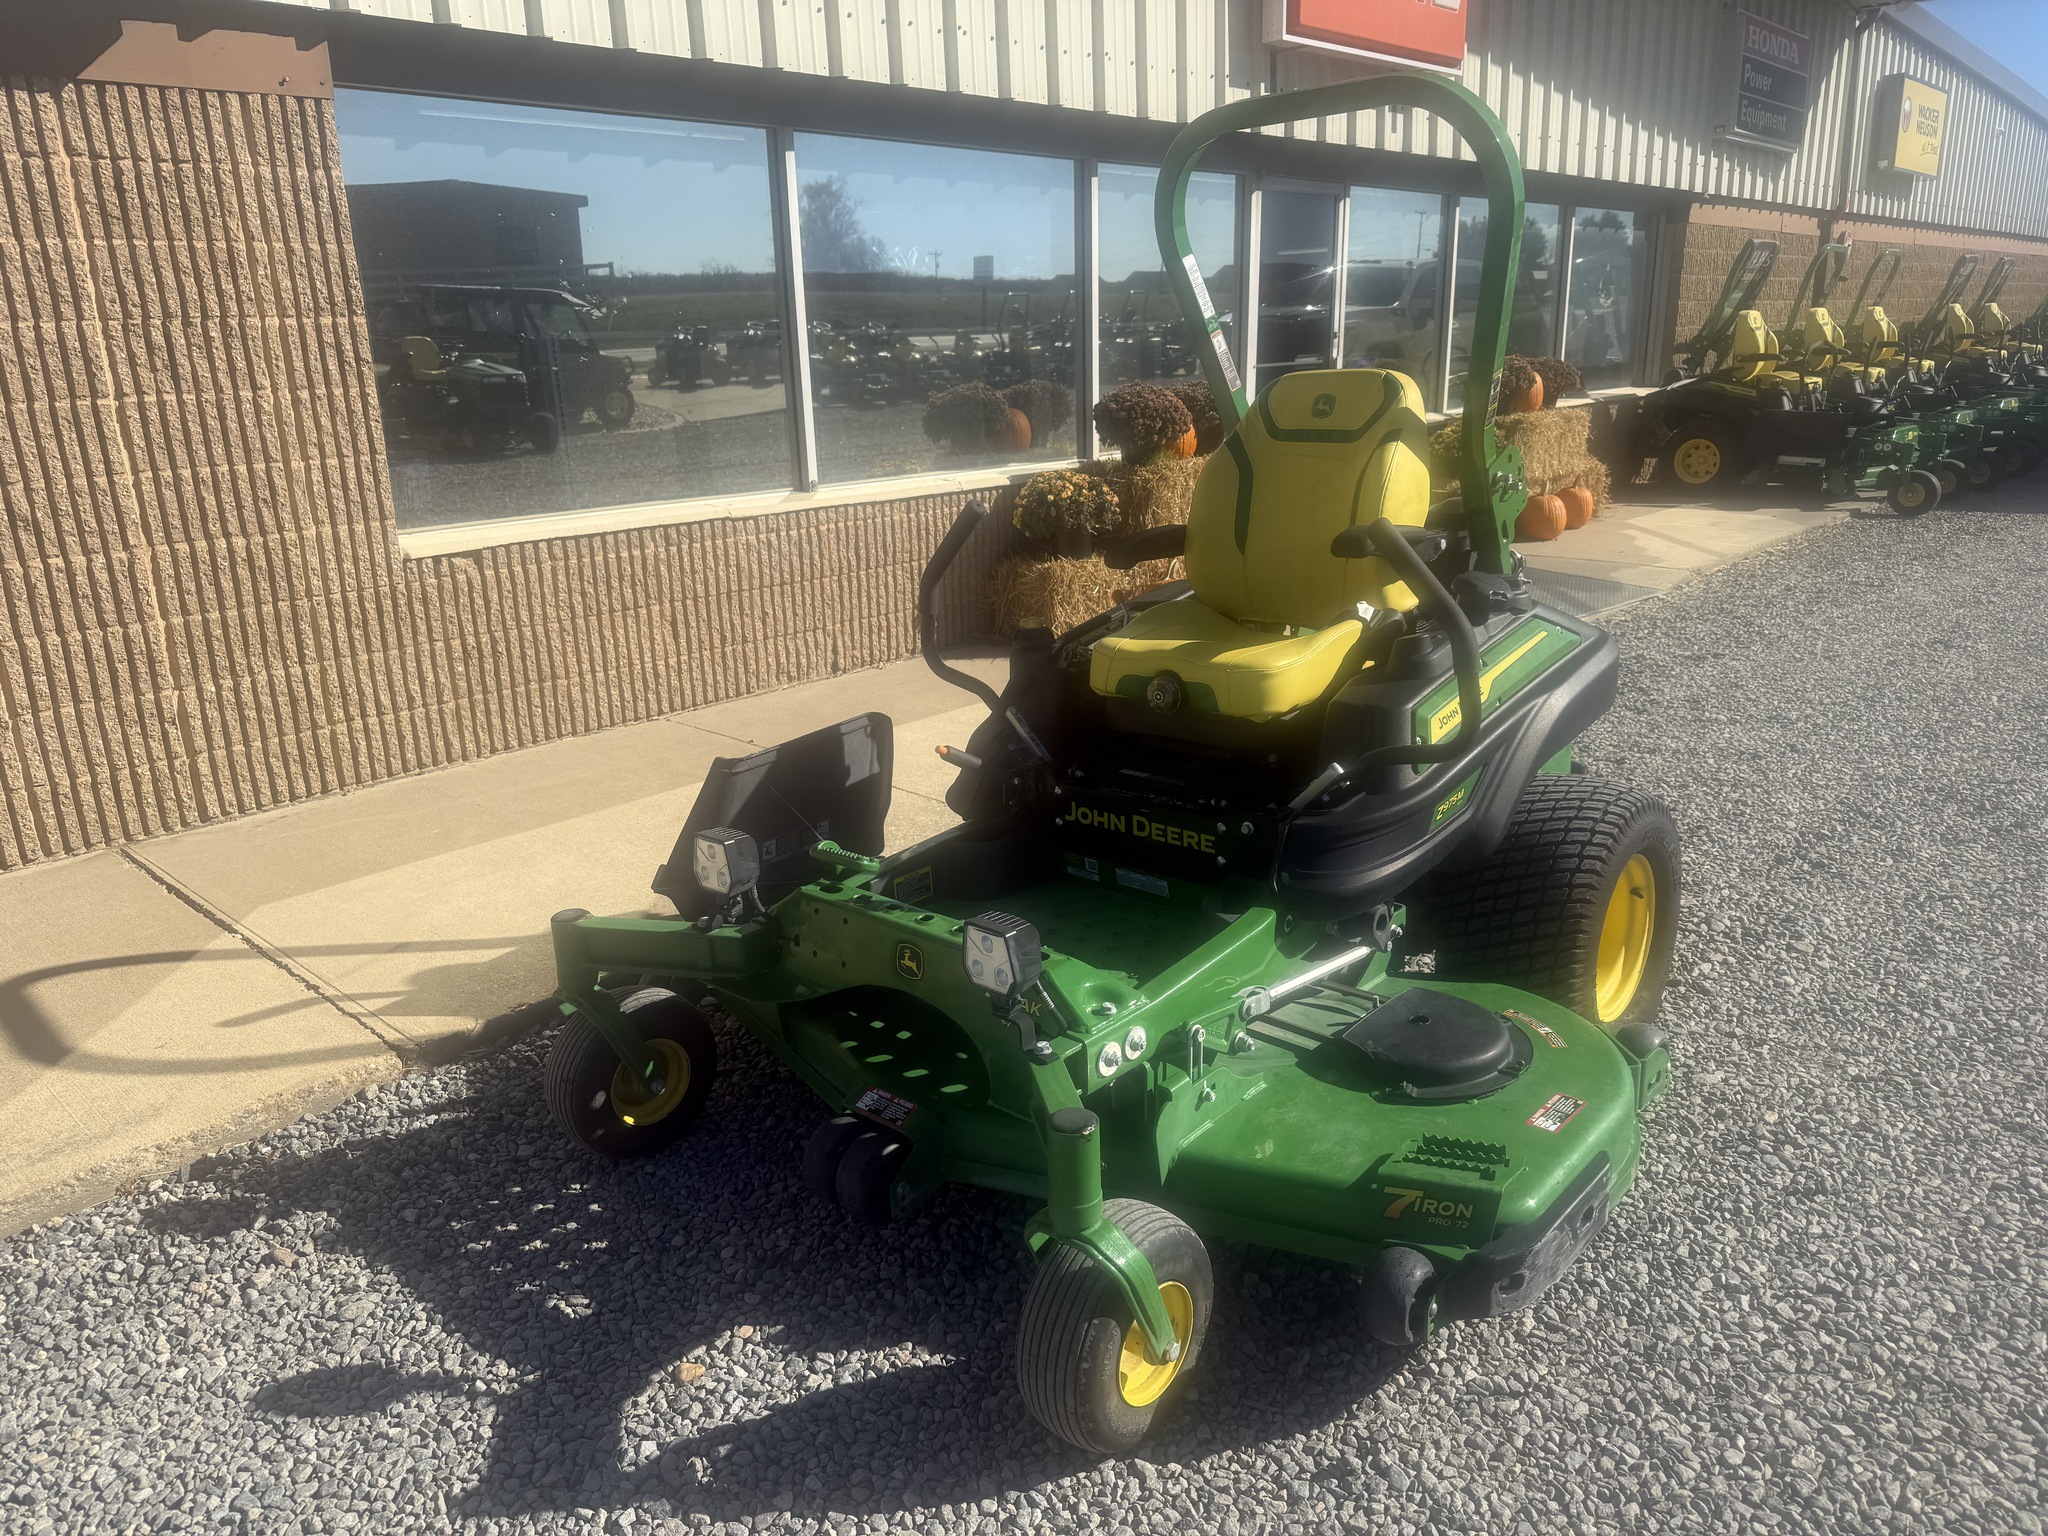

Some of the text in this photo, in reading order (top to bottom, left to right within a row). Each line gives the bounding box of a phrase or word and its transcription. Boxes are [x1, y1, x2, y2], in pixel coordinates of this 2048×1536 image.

[1747, 24, 1800, 64] HONDA
[1743, 63, 1772, 92] Power
[1741, 99, 1787, 131] Equipment
[1918, 103, 1940, 125] WACKER
[1915, 119, 1939, 139] NEUSON
[1438, 706, 1459, 730] JOHN
[1065, 801, 1216, 854] JOHN DEERE
[1427, 1216, 1469, 1229] PRO 72
